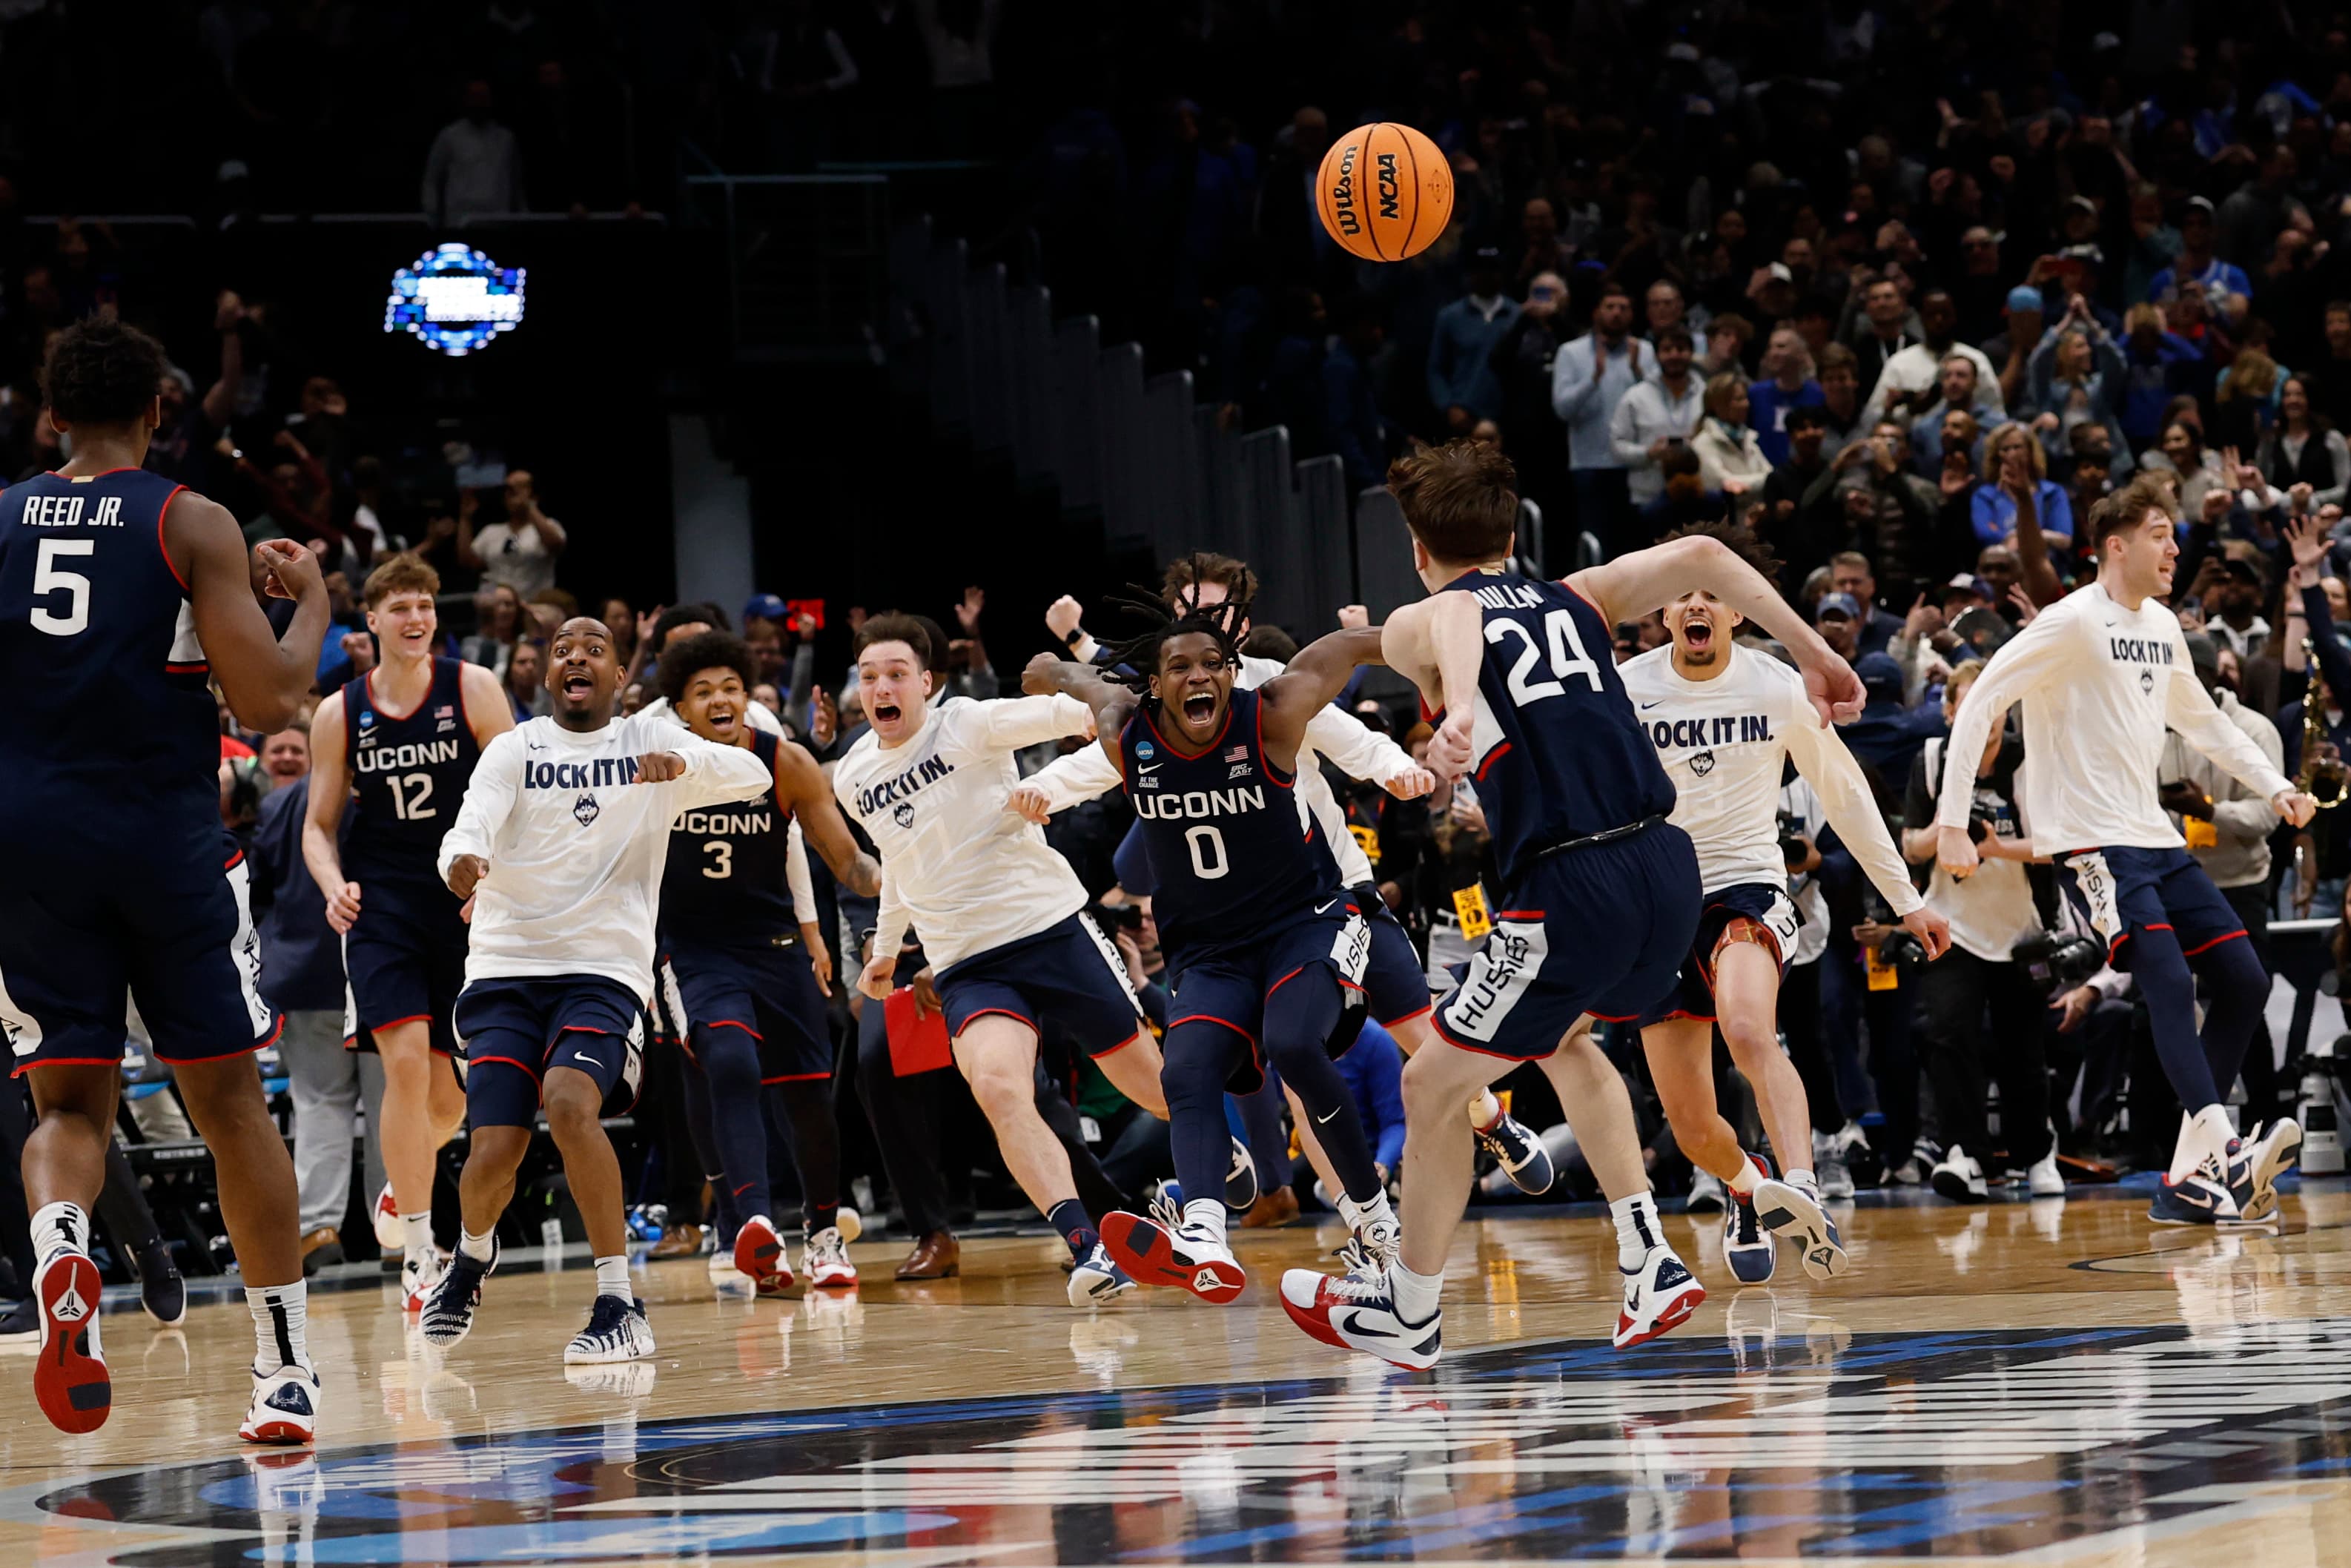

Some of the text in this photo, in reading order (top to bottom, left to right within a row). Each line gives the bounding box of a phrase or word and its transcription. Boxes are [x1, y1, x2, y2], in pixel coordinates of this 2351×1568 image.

[1333, 146, 1360, 236] Wilson
[1378, 153, 1398, 219] NCAA
[22, 496, 125, 527] REED JR.
[30, 538, 95, 636] 5
[1484, 609, 1604, 708] 24
[2111, 638, 2147, 663] LOCK
[2148, 641, 2160, 664] IT
[1713, 717, 1736, 745] IT
[1741, 715, 1774, 742] IN.
[356, 739, 458, 773] UCONN
[524, 760, 588, 790] LOCK
[592, 758, 615, 787] IT
[899, 766, 921, 795] IT
[918, 753, 955, 785] IN.
[1229, 767, 1253, 778] EAST
[1231, 763, 1248, 772] BIG
[386, 773, 437, 820] 12
[1133, 785, 1266, 820] UCONN
[702, 840, 733, 879] 3
[1185, 825, 1229, 879] 0
